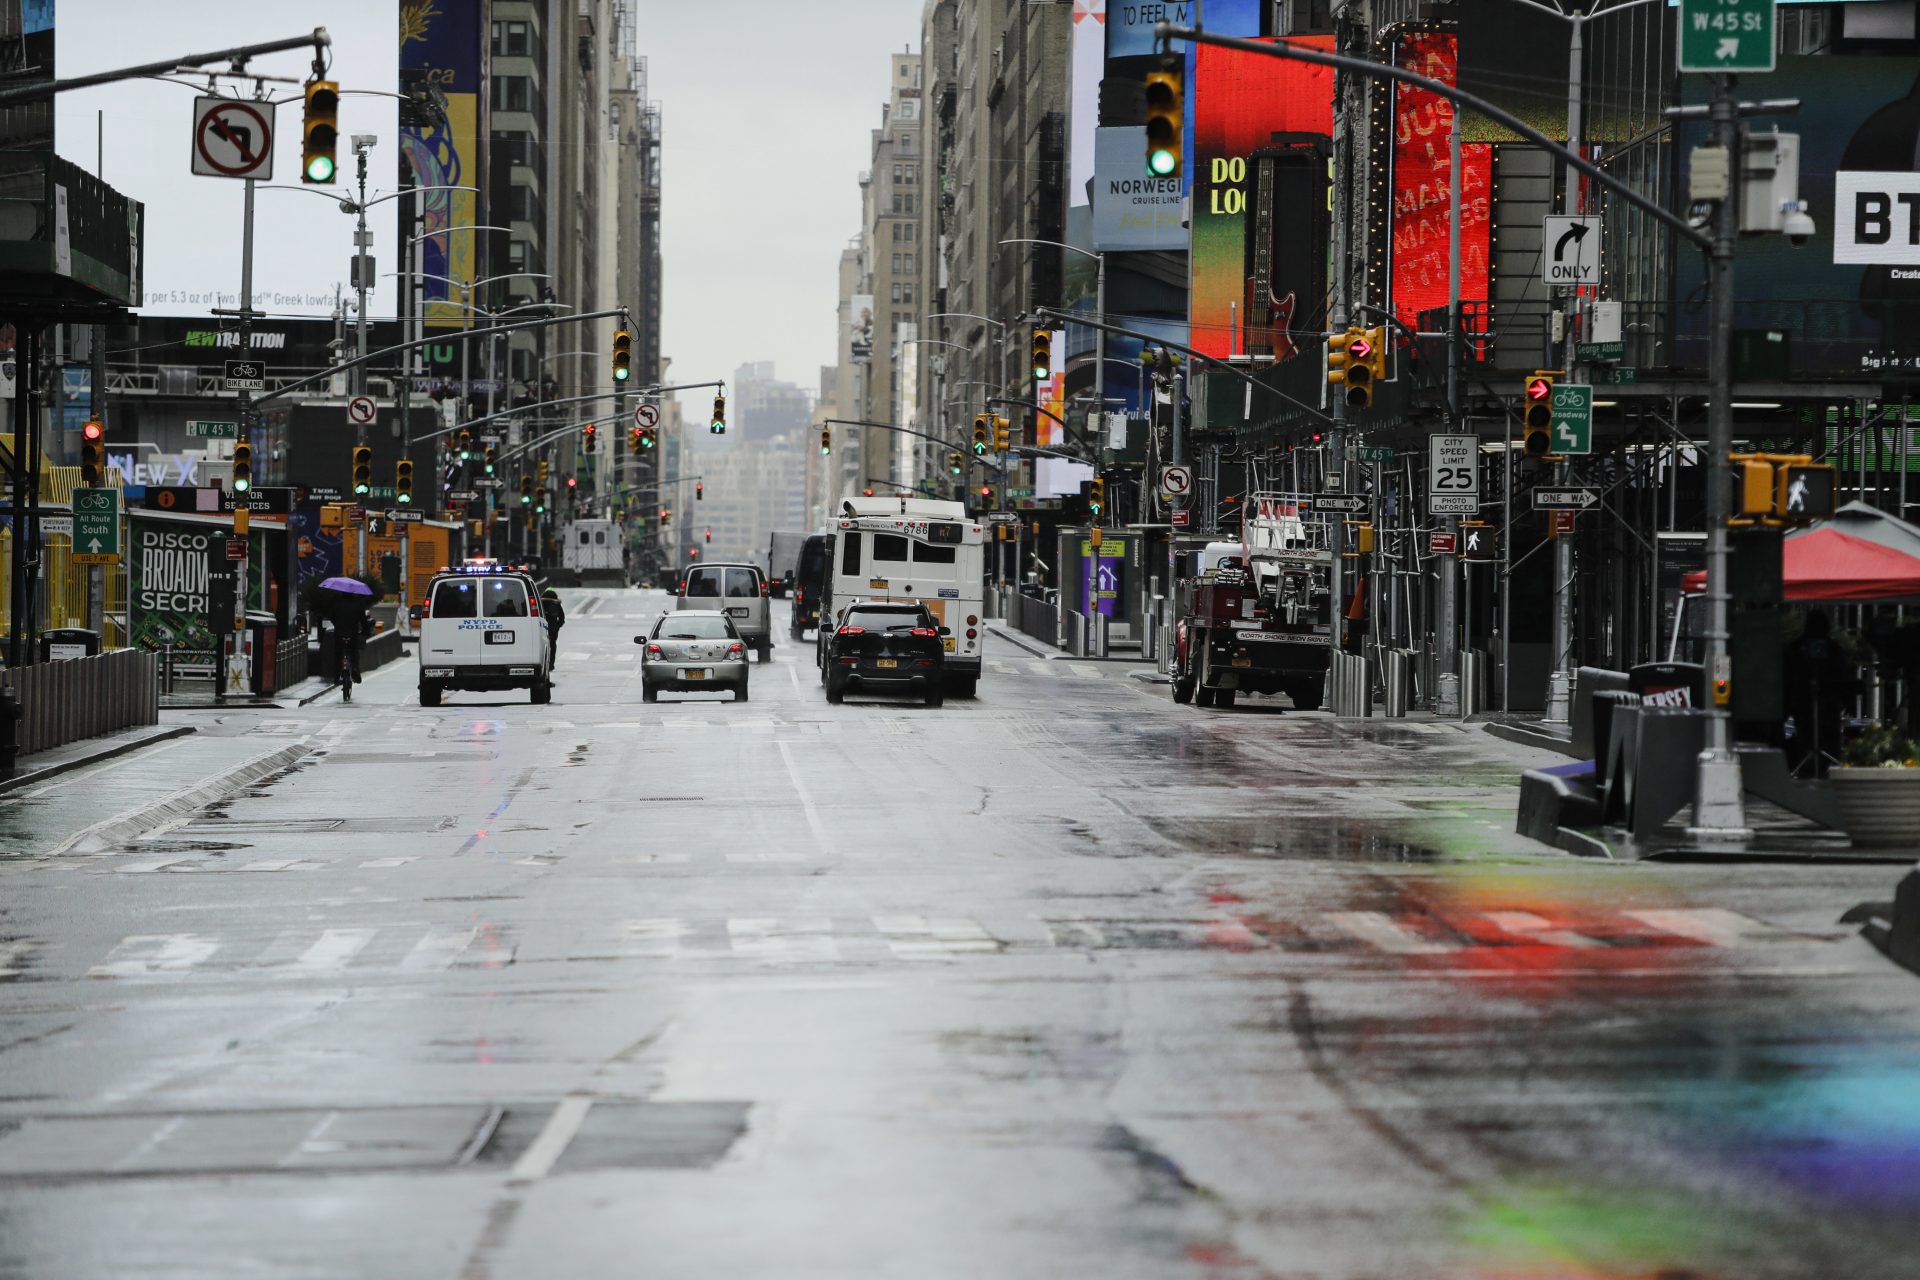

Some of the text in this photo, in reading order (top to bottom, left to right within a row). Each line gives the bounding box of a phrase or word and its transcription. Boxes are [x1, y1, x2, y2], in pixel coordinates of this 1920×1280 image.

[1123, 6, 1137, 26] TO
[1692, 12, 1762, 31] W 45 St
[1132, 197, 1160, 205] CRUISE
[1211, 187, 1247, 214] LO
[1552, 265, 1591, 278] ONLY
[151, 292, 168, 305] per
[171, 291, 187, 303] 5.3
[189, 294, 200, 303] oz
[201, 291, 212, 303] of
[216, 291, 235, 304] Two
[274, 292, 302, 305] Greek
[1577, 344, 1600, 356] George
[227, 379, 262, 388] BIKE LANE
[199, 423, 208, 436] W
[212, 424, 224, 436] 45
[1444, 439, 1464, 447] CITY
[1359, 448, 1368, 460] W
[1371, 449, 1383, 460] 45
[1440, 448, 1468, 456] SPEED
[1442, 457, 1465, 465] LIMIT
[1437, 467, 1473, 489] 25
[1320, 499, 1361, 508] ONE WAY
[1543, 494, 1591, 503] ONE WAY
[91, 515, 111, 523] Route
[82, 525, 109, 535] South
[903, 525, 928, 535] 6786
[143, 531, 208, 550] DISCO
[141, 591, 208, 614] SECR
